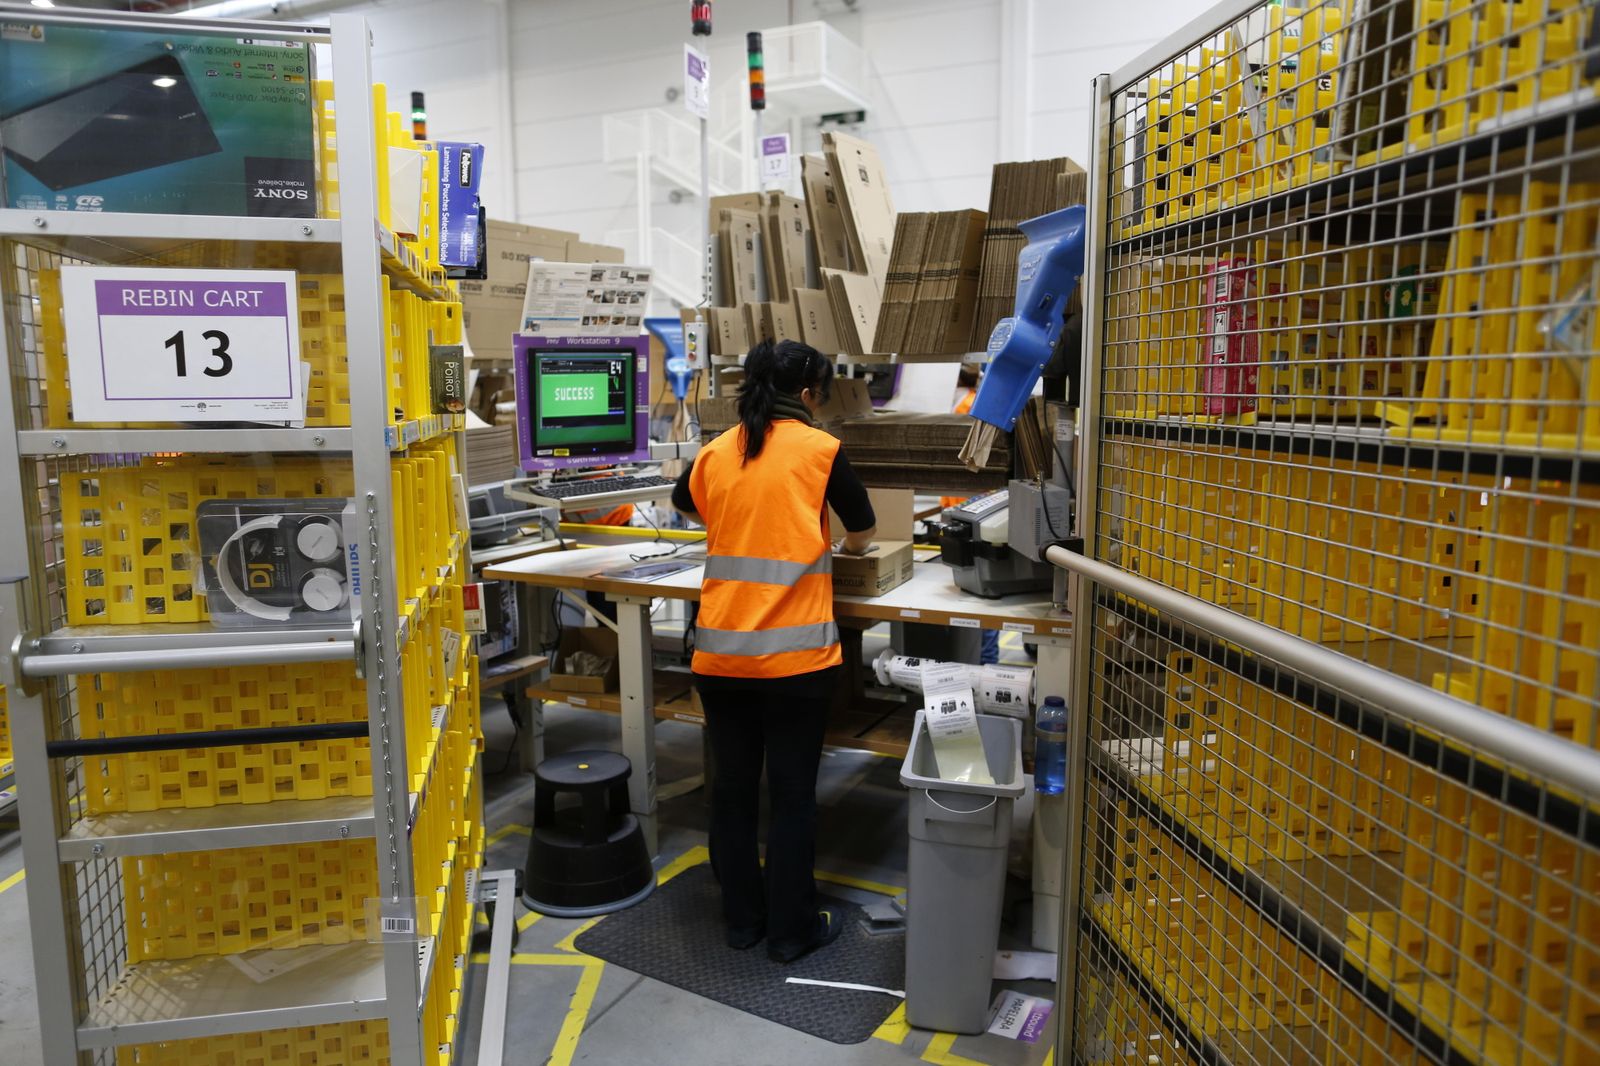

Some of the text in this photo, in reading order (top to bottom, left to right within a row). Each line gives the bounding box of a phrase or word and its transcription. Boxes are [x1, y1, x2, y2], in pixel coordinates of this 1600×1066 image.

[178, 44, 204, 55] Video
[215, 47, 241, 57] Audio
[244, 49, 278, 59] Internet
[460, 151, 471, 185] Fellowes
[769, 159, 782, 169] 17
[253, 187, 309, 200] SONY
[440, 146, 452, 262] Laminating Pouches Selection Guide
[121, 288, 264, 308] REBIN CART
[566, 337, 611, 345] Workstation
[614, 337, 621, 345] 9
[163, 329, 234, 378] 13
[610, 361, 622, 374] E4
[444, 361, 455, 398] POIROT
[554, 386, 595, 401] SUCCESS
[247, 562, 274, 588] DJ
[999, 998, 1025, 1030] PAPELERA
